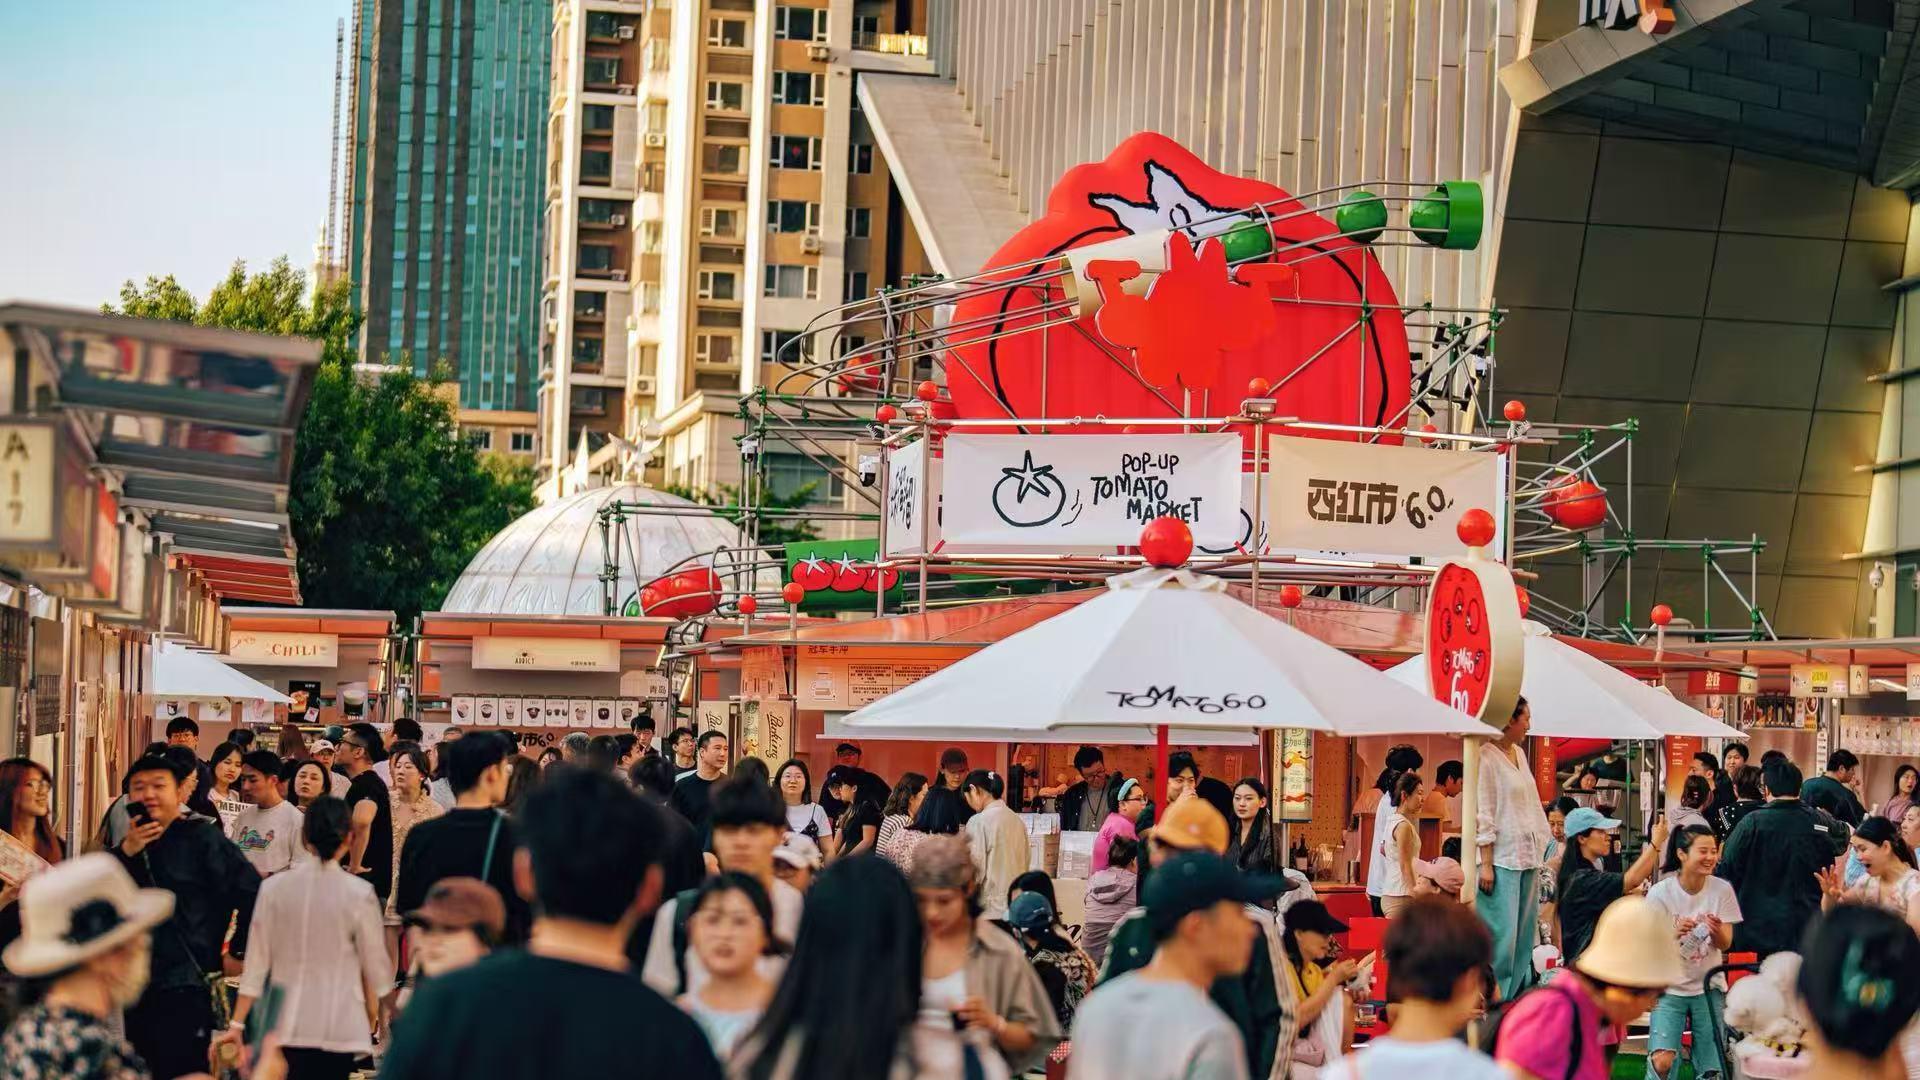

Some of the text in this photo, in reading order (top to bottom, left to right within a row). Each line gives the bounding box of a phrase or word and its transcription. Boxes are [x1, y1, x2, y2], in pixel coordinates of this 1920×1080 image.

[1122, 452, 1179, 475] POP-UP
[1090, 473, 1168, 505] TOMATO
[1308, 478, 1398, 525] 西红市
[1126, 497, 1202, 525] MARKET
[272, 643, 317, 657] CHILI
[1106, 685, 1224, 714] TOMATO
